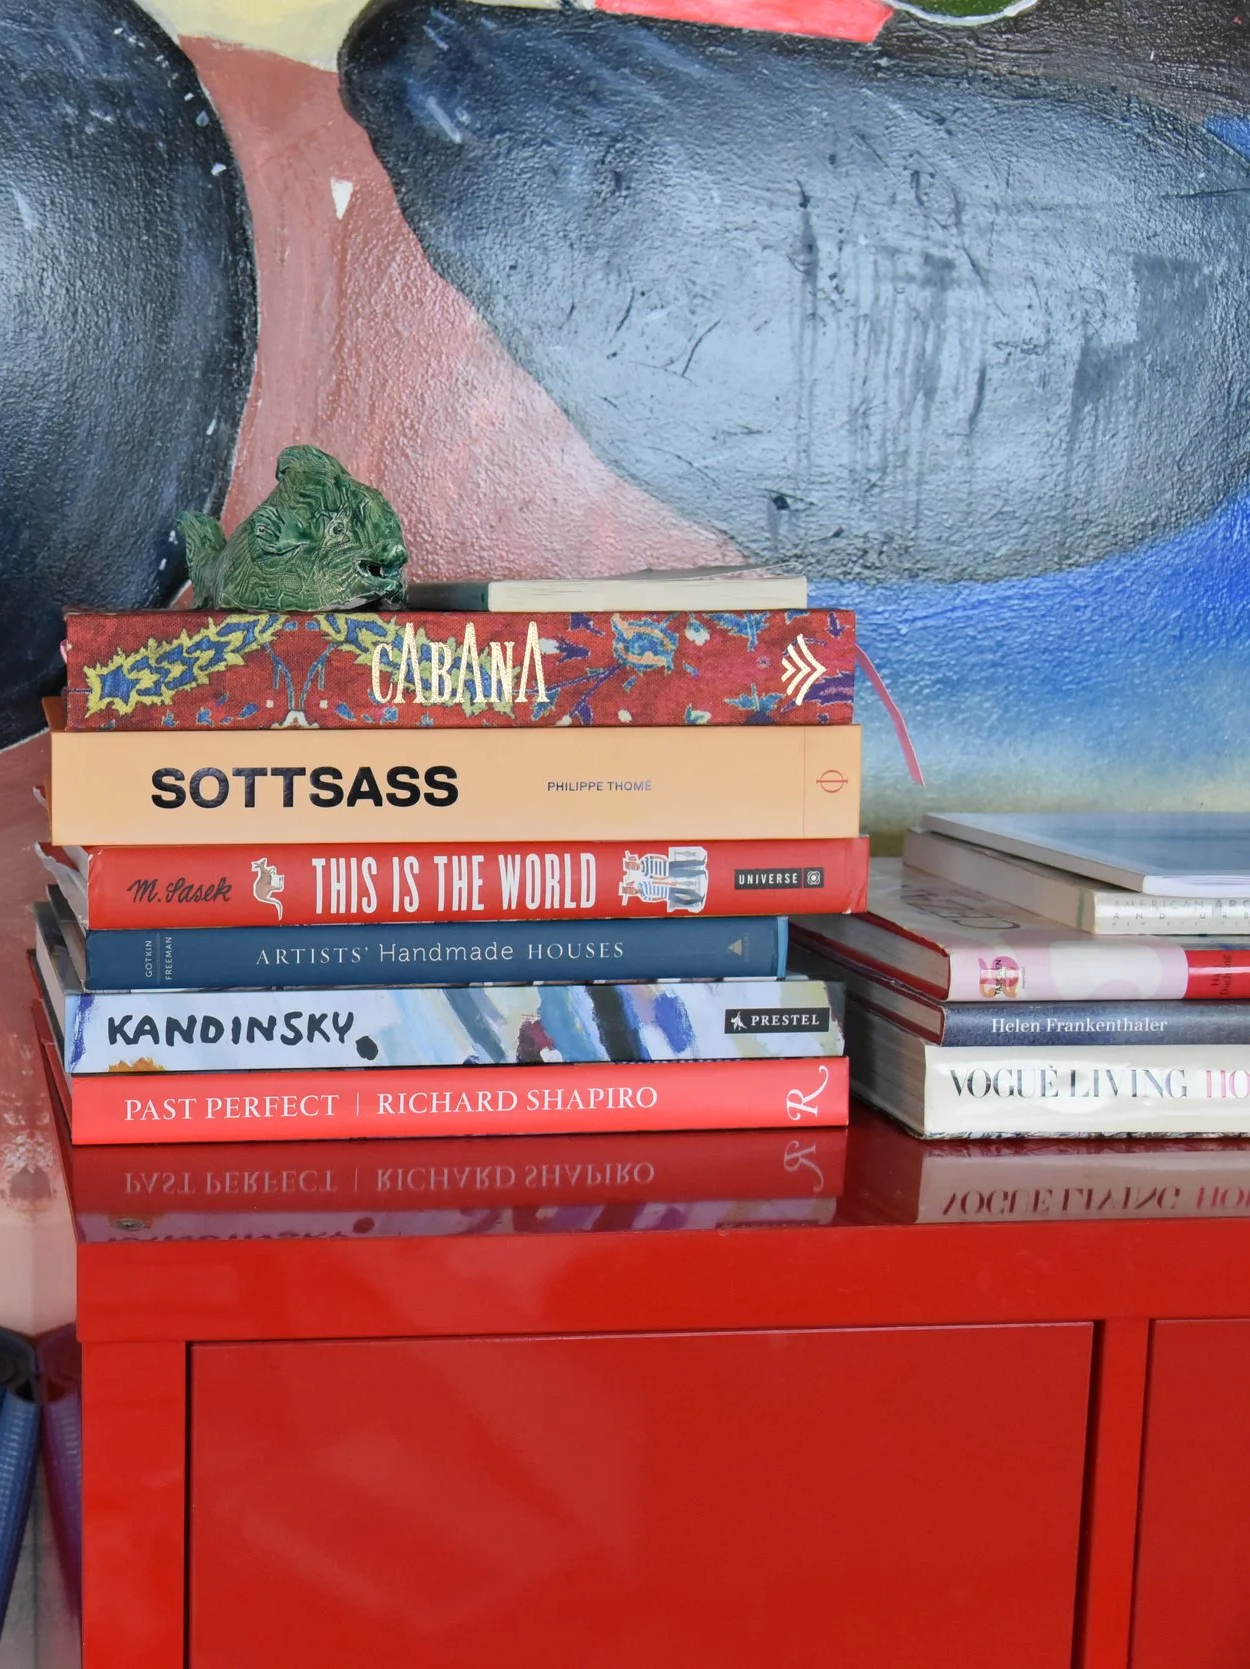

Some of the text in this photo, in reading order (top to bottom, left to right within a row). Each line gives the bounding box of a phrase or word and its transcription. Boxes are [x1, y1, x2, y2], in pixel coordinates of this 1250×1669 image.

[371, 621, 550, 704] CABANA
[150, 765, 459, 809] SOTTSASS
[547, 778, 652, 792] PHILIPPE THOMÉ
[127, 876, 234, 904] M. Sasek
[311, 852, 597, 914] THIS IS THE WORLD
[738, 871, 799, 885] UNIVERSE
[1113, 912, 1166, 920] AND
[145, 939, 153, 978] GOTKIN
[165, 936, 173, 981] FREEMAN
[255, 941, 624, 965] ARTISTS’ Handmade HOUSES
[107, 1010, 355, 1047] KANDINSKY
[750, 1013, 821, 1027] PRESTEL
[991, 1016, 1169, 1034] Helen Frankenthaler
[785, 1064, 830, 1121] R
[950, 1068, 1059, 1099] VOGUE
[1069, 1068, 1188, 1099] LIVING
[124, 1085, 659, 1122] PAST PERFECT RICHARD SHAPIRO
